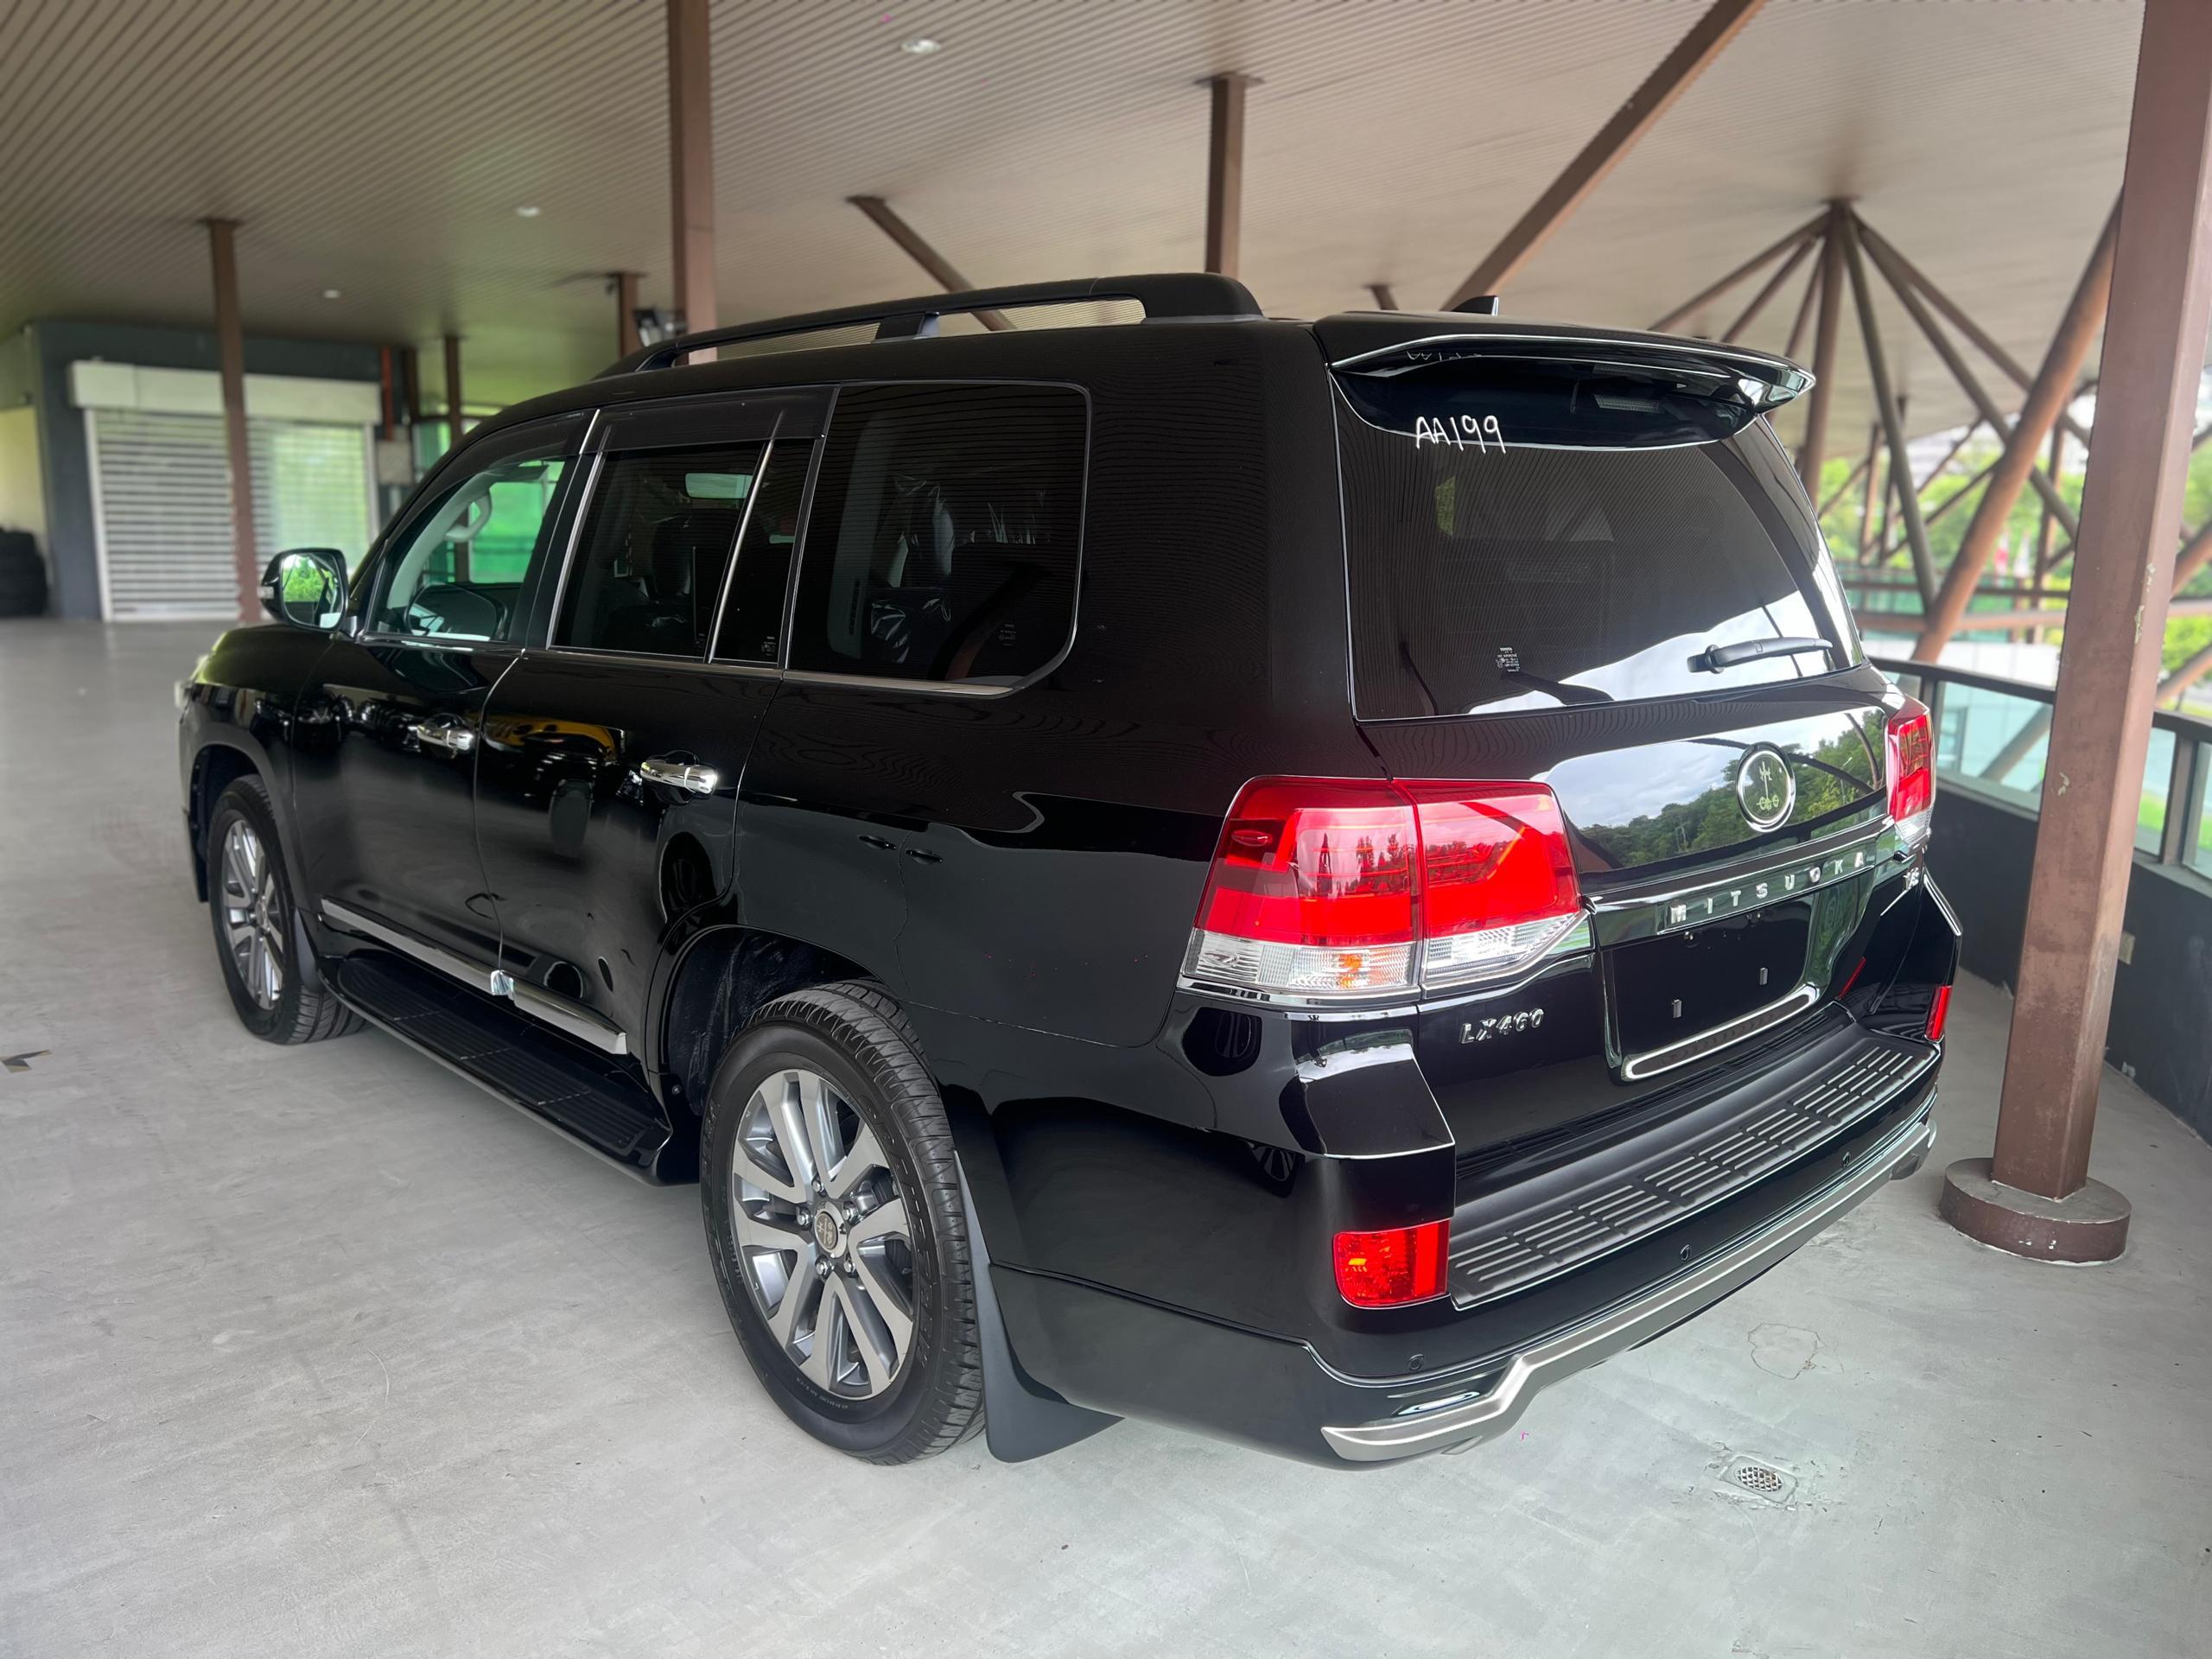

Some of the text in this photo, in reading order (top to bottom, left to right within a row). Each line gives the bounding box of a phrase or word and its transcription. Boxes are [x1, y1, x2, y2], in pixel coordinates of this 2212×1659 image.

[1416, 415, 1507, 454] AA199
[1670, 852, 1865, 924] MITSUOKA
[1459, 1008, 1544, 1044] LX460
